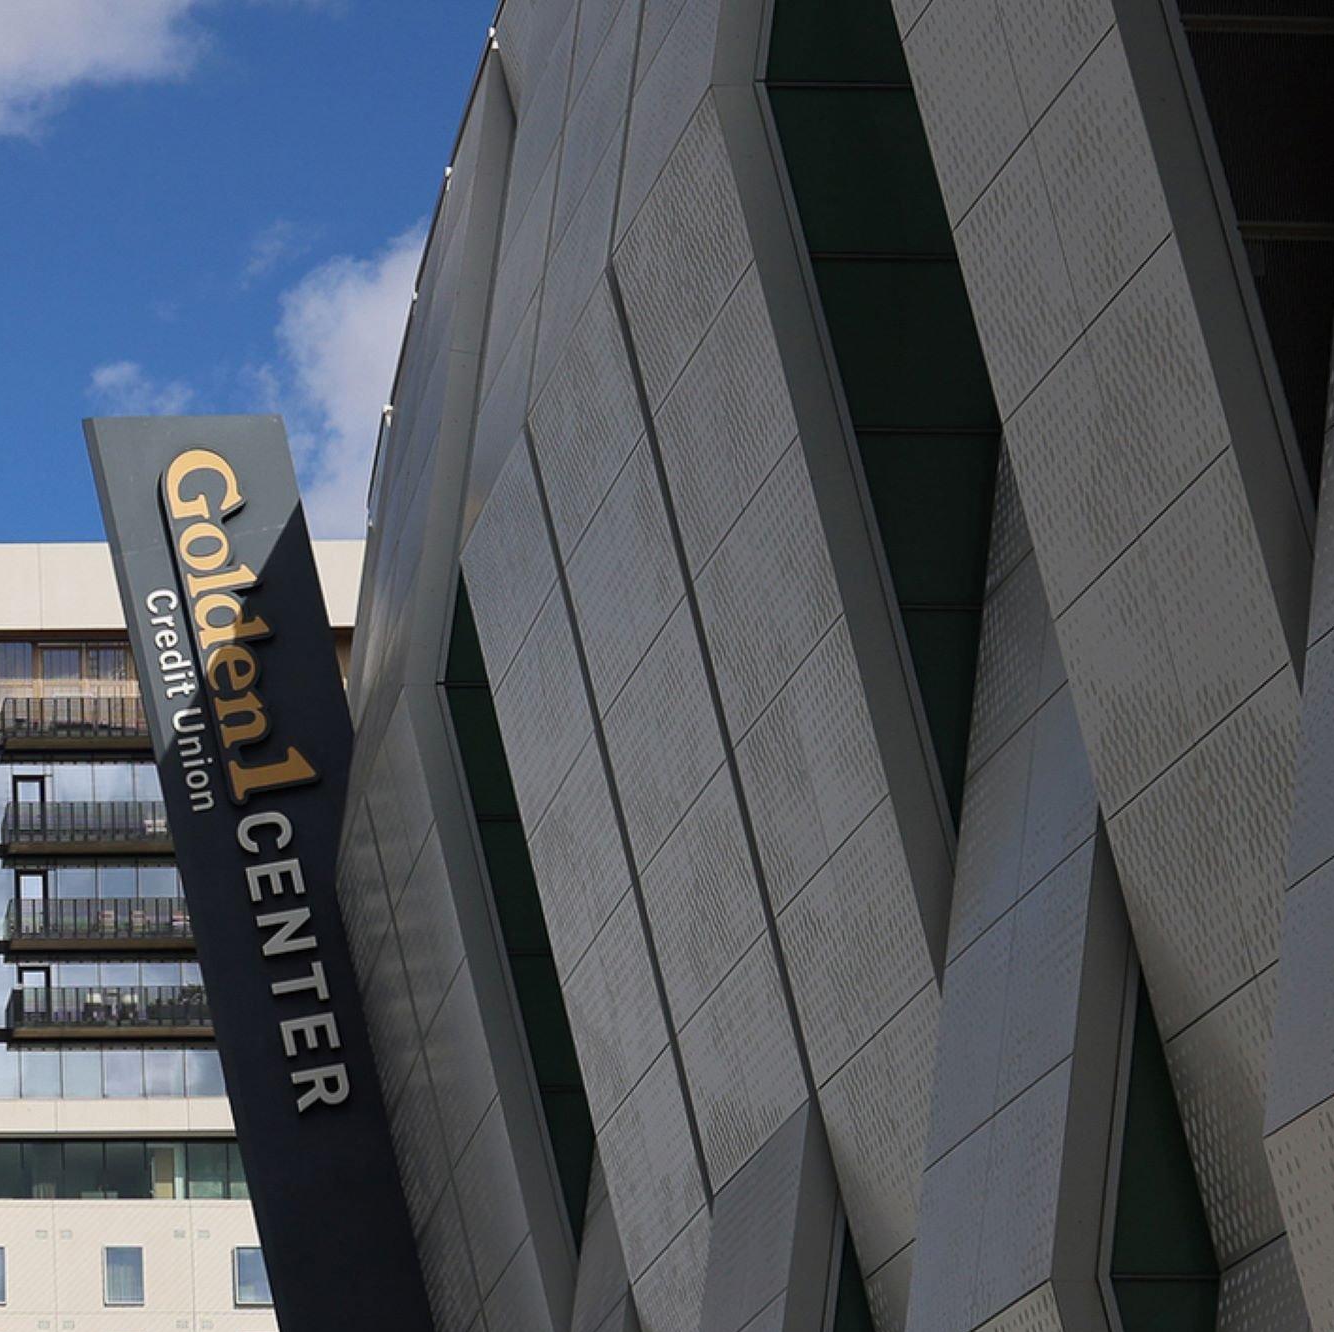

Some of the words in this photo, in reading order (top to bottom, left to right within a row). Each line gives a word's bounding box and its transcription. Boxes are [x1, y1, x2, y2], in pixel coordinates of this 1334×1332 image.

[146, 588, 197, 698] Credit
[172, 706, 216, 812] Union
[166, 449, 270, 749] Golden
[237, 811, 351, 1113] CENTER
